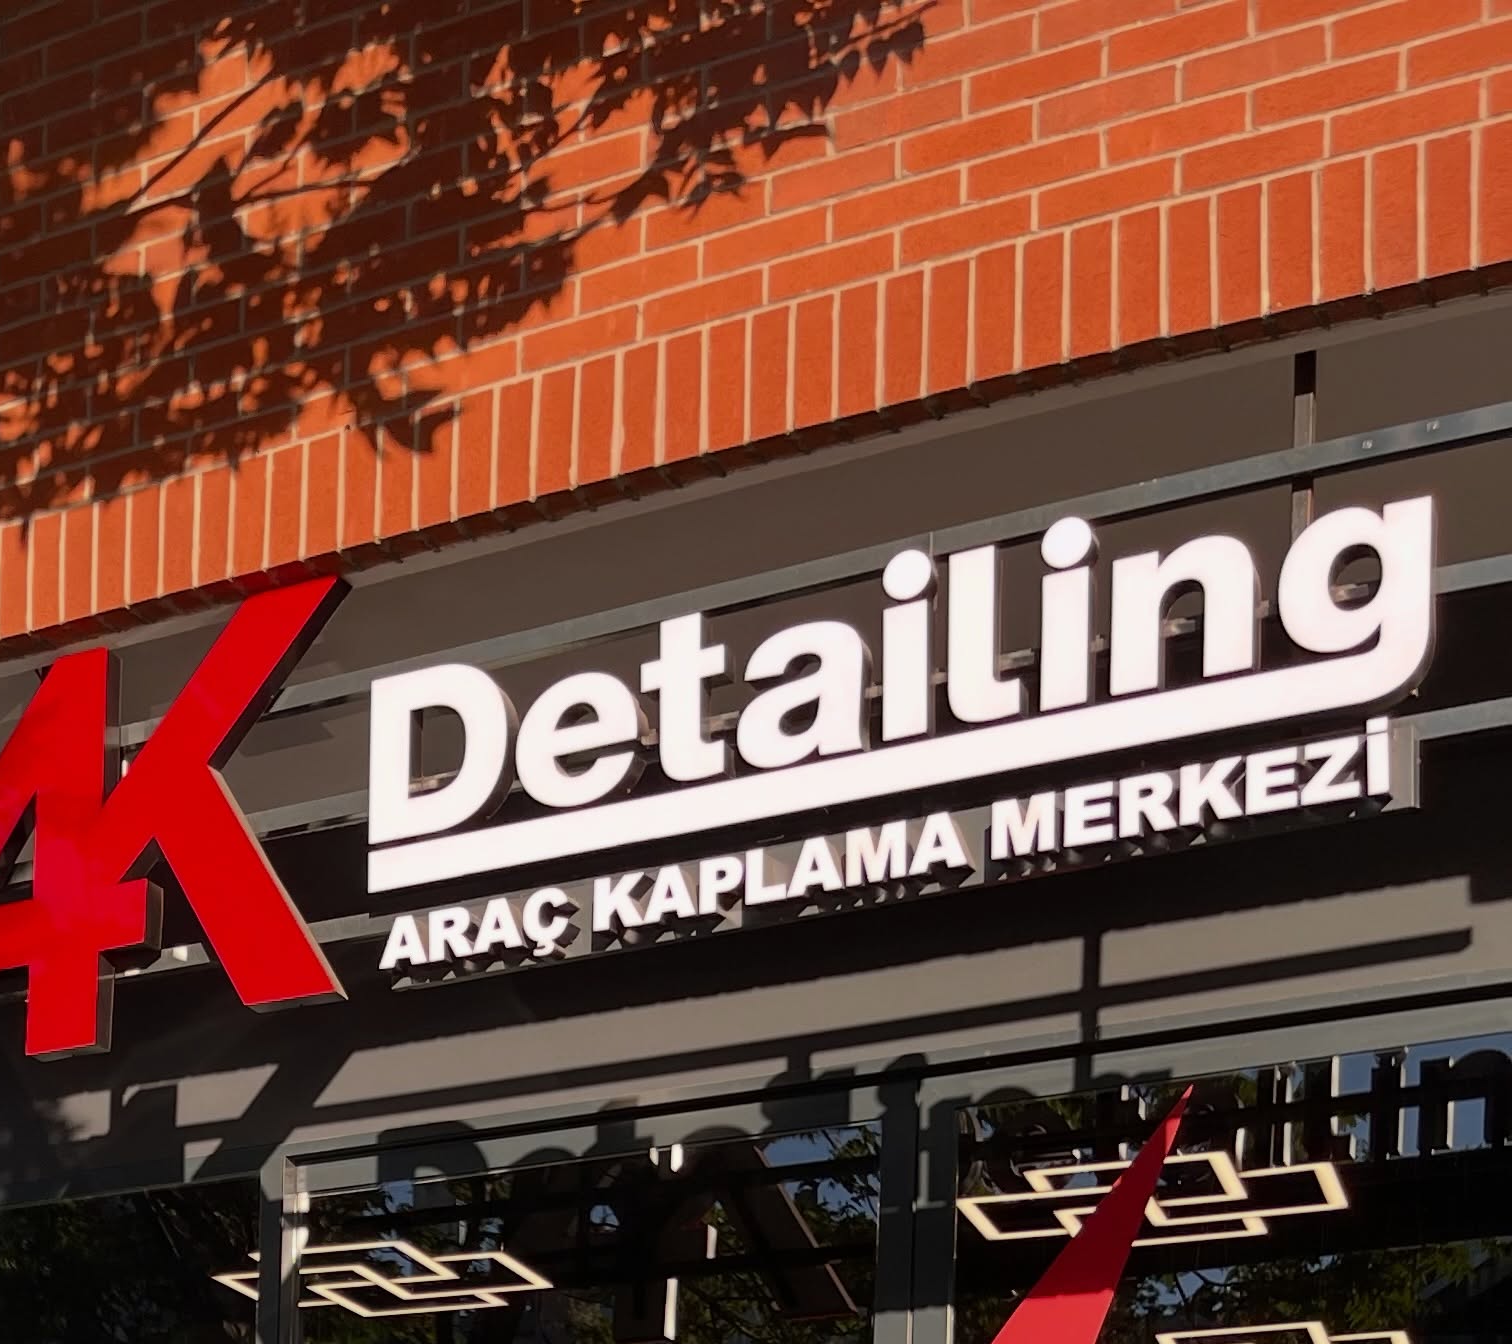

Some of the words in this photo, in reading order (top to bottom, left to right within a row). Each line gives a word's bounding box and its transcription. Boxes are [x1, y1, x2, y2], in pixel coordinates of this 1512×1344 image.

[367, 496, 1434, 860] Detailing
[379, 887, 569, 970] ARAÇ
[592, 812, 968, 932] KAPLAMA
[990, 716, 1391, 861] MERKEZİ
